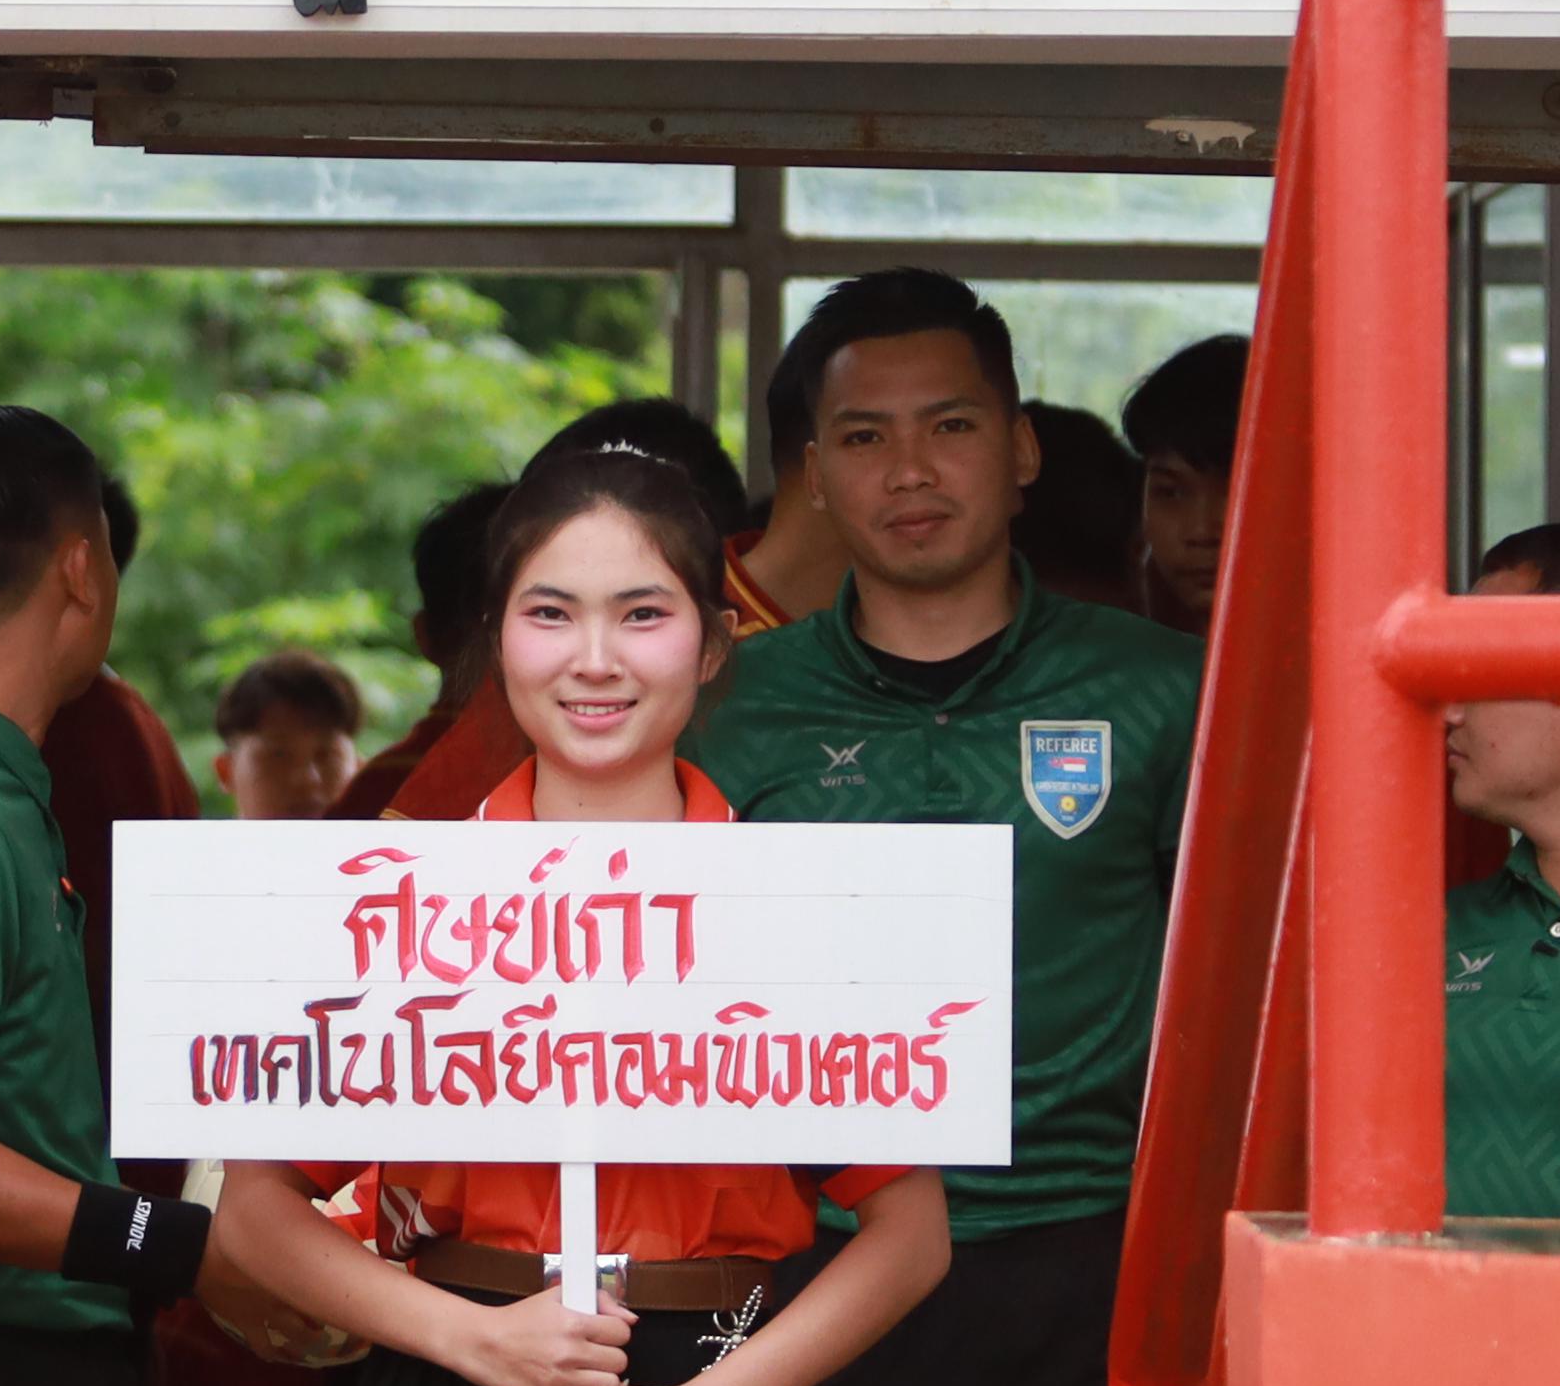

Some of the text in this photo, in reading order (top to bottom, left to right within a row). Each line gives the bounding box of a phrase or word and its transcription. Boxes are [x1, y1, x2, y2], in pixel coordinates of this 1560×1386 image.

[1035, 737, 1098, 754] REFEREE
[337, 835, 700, 985] ศิษย์เก่า
[126, 1197, 152, 1250] AOLIKES
